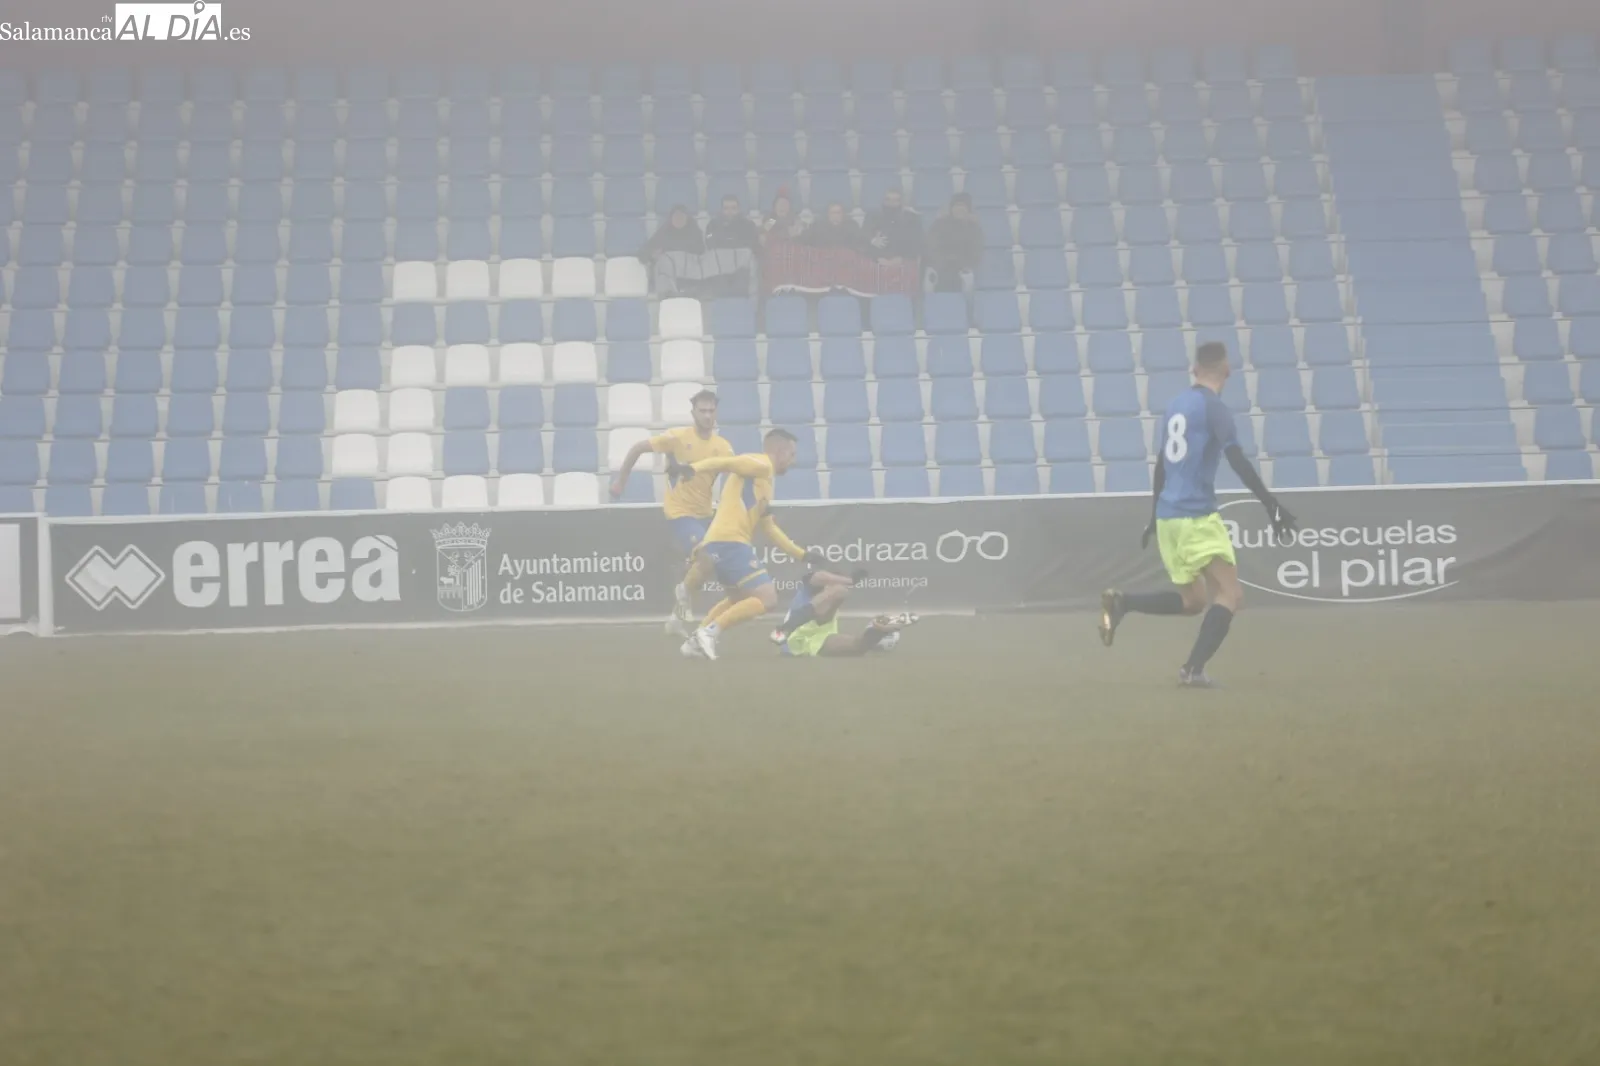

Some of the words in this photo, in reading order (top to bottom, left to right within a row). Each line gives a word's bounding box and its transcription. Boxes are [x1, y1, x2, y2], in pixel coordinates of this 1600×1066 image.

[1165, 413, 1188, 463] 8
[498, 551, 645, 579] Ayuntamiento
[1277, 551, 1320, 588] el
[1341, 549, 1457, 597] pilar
[499, 582, 524, 604] de
[531, 580, 645, 604] Salamanca
[848, 575, 929, 589] alamanca
